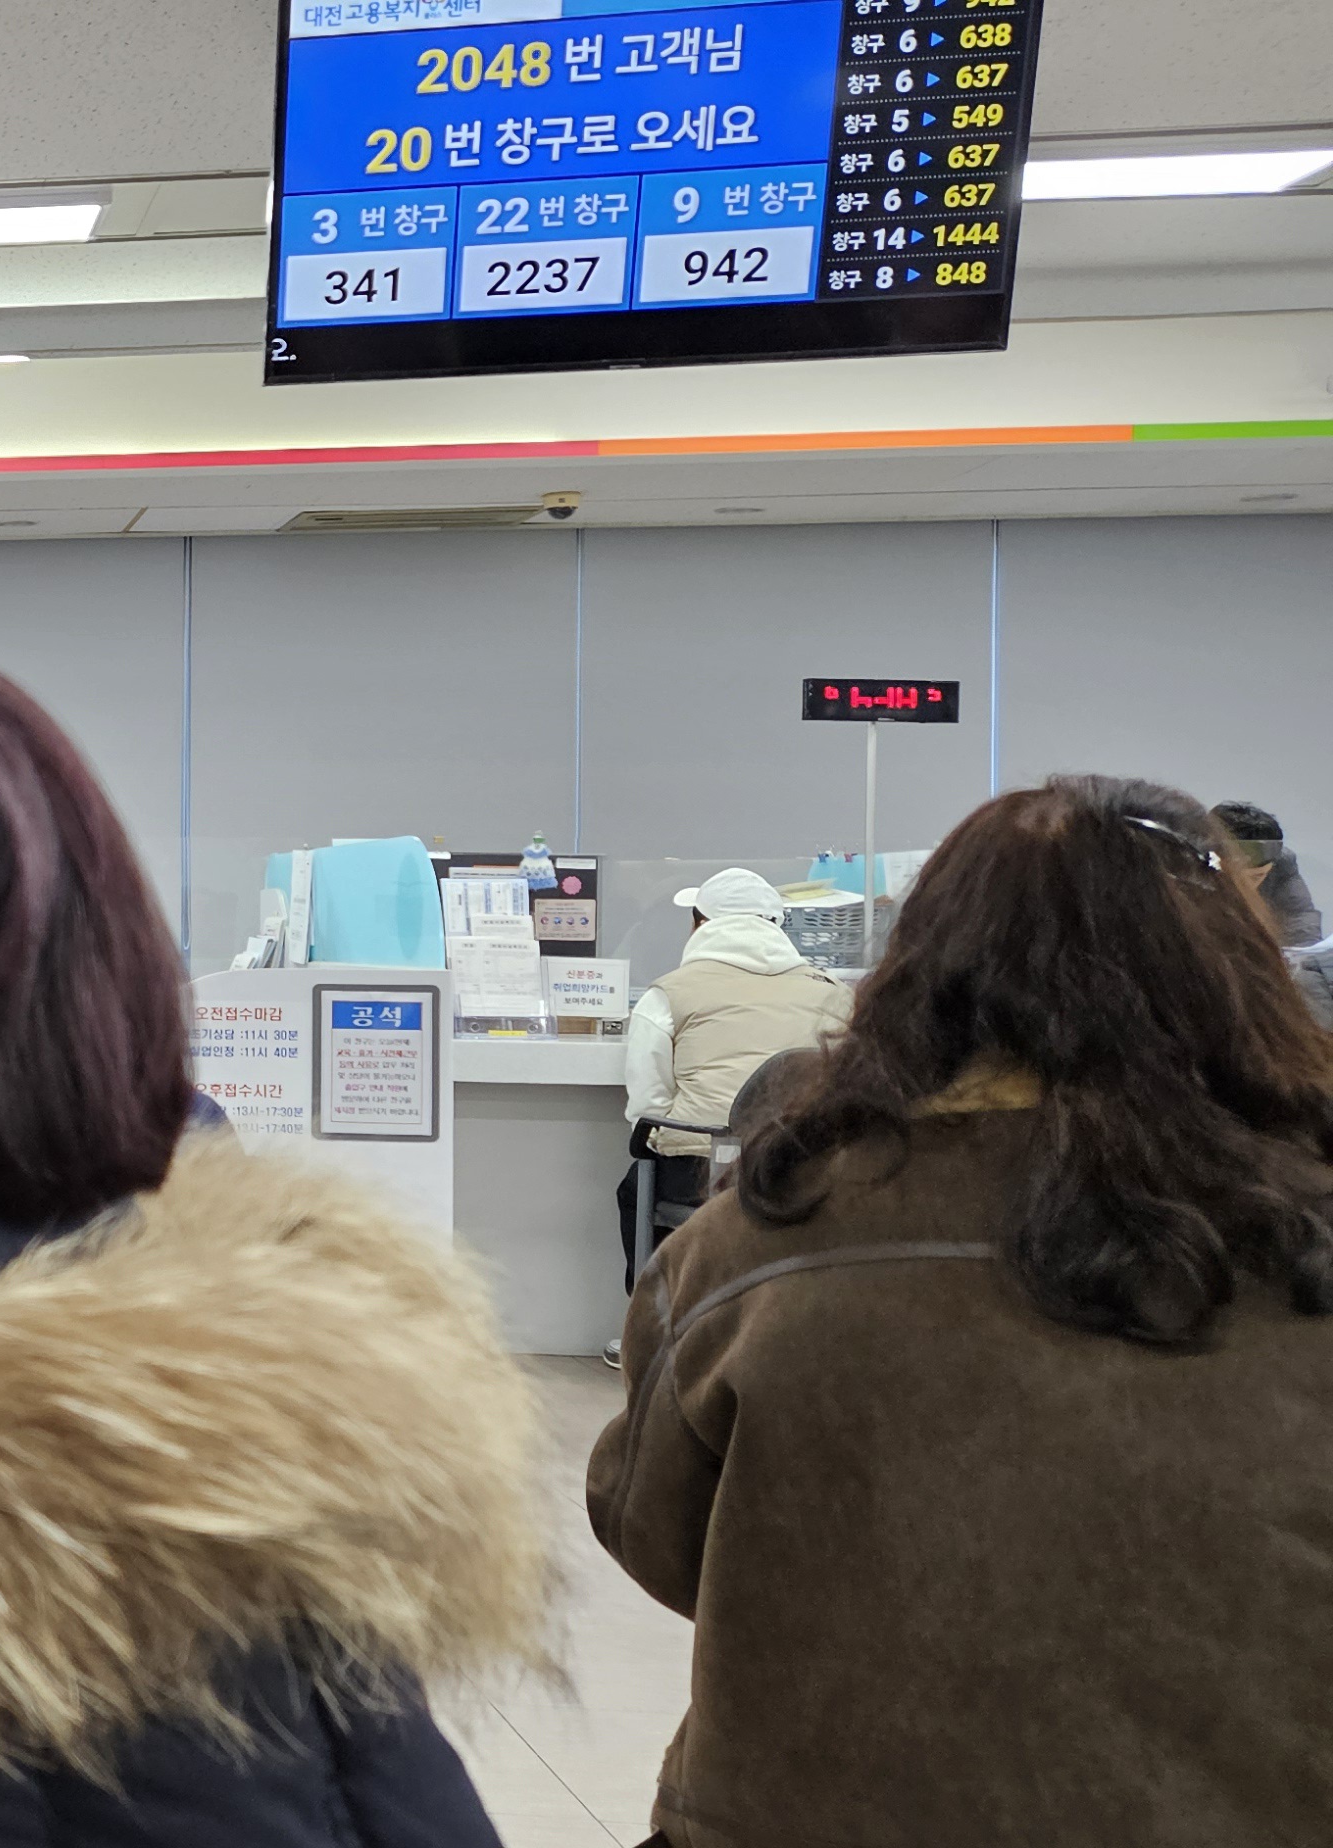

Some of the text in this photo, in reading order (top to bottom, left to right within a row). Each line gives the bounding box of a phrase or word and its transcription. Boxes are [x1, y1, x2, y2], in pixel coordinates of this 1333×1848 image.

[851, 23, 1012, 54] 창구 6 638
[416, 24, 744, 95] 2048 번 고객님
[847, 63, 1009, 95] 창구 6 637
[843, 104, 1004, 134] 창구 5 549
[364, 105, 759, 175] 20 번 창구로 오세요
[840, 144, 1000, 174] 창구 6 637
[673, 181, 818, 224] 9 번 창구
[836, 183, 996, 213] 창구 6 637
[311, 203, 450, 245] 3 번 창구
[476, 192, 630, 236] 22 번 창구
[832, 222, 1000, 252] 창구 14 1444
[486, 256, 601, 297] 2237
[683, 246, 770, 287] 942
[828, 261, 987, 290] 창구 8 848
[324, 266, 402, 305] 341
[195, 1006, 283, 1022] 오전접수마감
[351, 1006, 402, 1028] 공석
[273, 1029, 299, 1042] 30분
[273, 1046, 299, 1059] 40분
